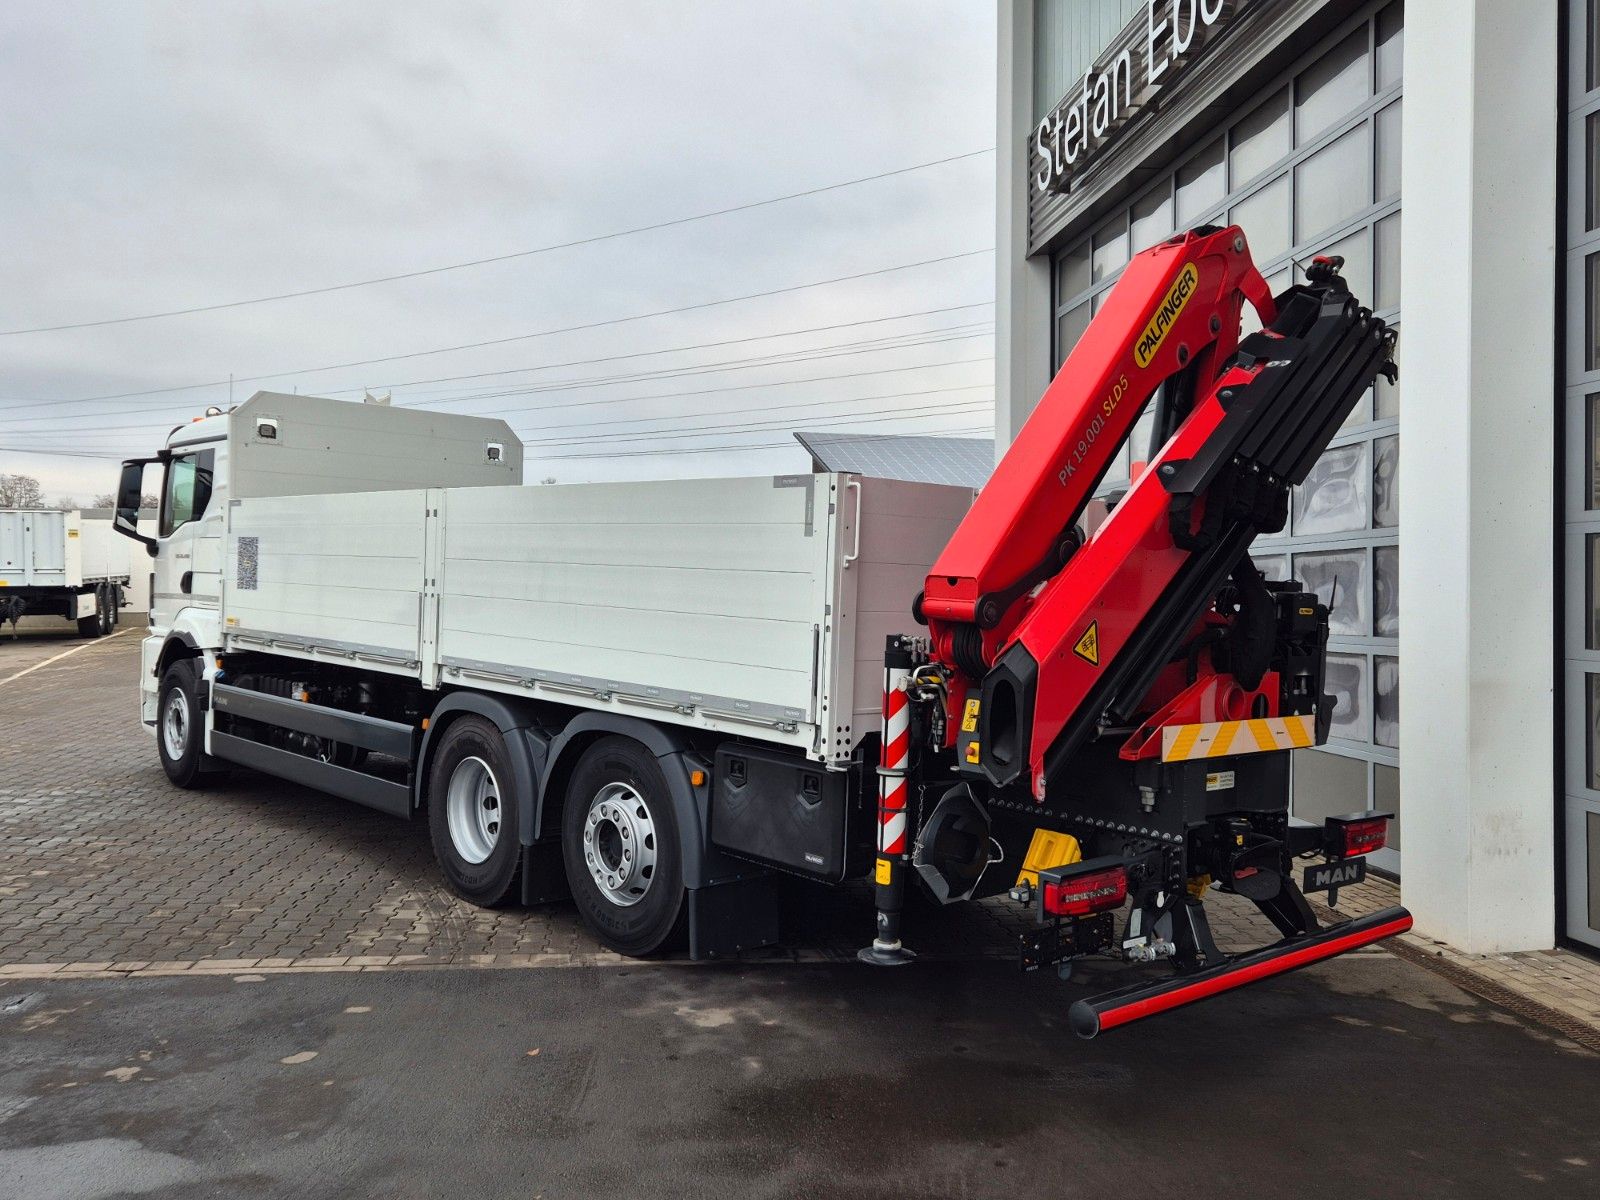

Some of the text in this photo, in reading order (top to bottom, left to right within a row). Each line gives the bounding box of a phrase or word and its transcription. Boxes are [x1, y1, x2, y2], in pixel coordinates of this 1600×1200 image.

[1037, 49, 1131, 191] Stefan
[1137, 268, 1196, 363] PALFINGER
[1058, 373, 1130, 487] PK 19.001 SLD5
[1315, 864, 1358, 887] MAN
